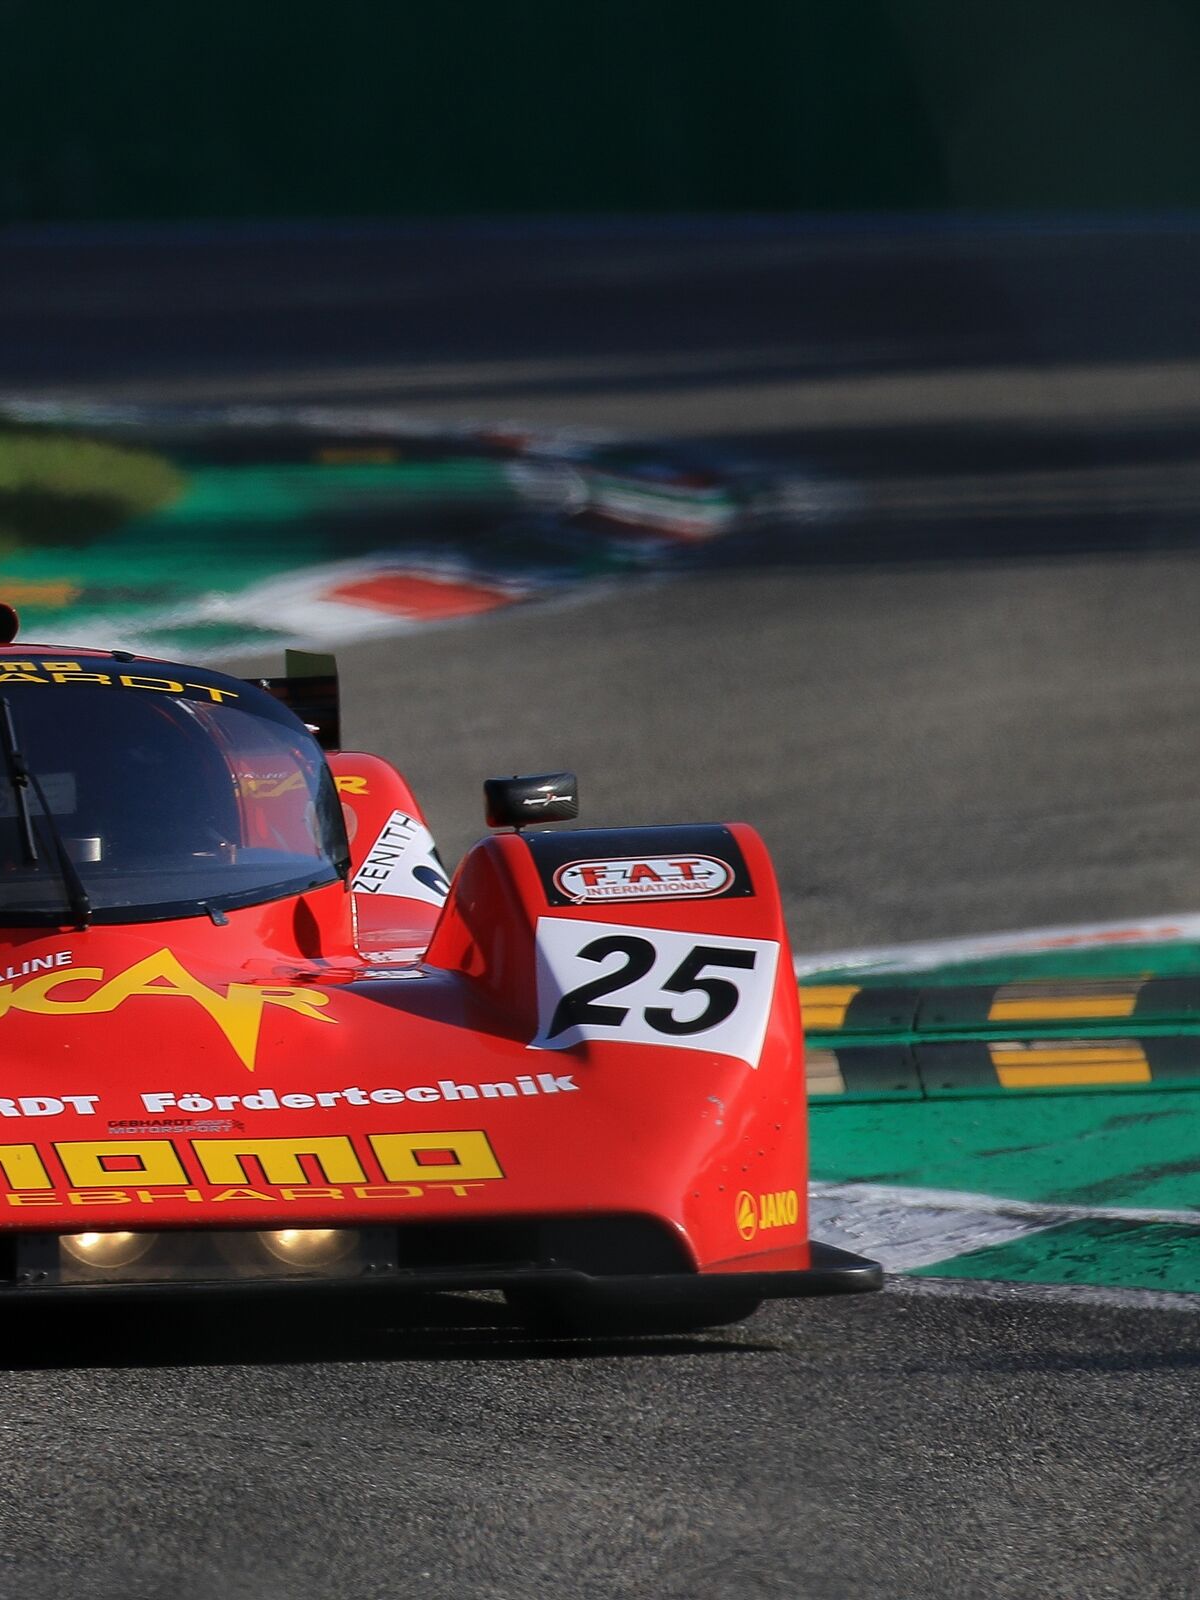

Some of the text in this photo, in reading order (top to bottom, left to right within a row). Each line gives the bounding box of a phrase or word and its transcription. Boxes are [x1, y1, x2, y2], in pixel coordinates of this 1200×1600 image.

[351, 811, 422, 894] ZENITH
[585, 881, 712, 896] INTERNATIONAL
[546, 935, 757, 1039] 25
[141, 1073, 579, 1113] Fördertechnik
[107, 1118, 193, 1128] GEBHARDT
[107, 1125, 232, 1135] MOTORSPORT
[759, 1190, 798, 1229] JAKO
